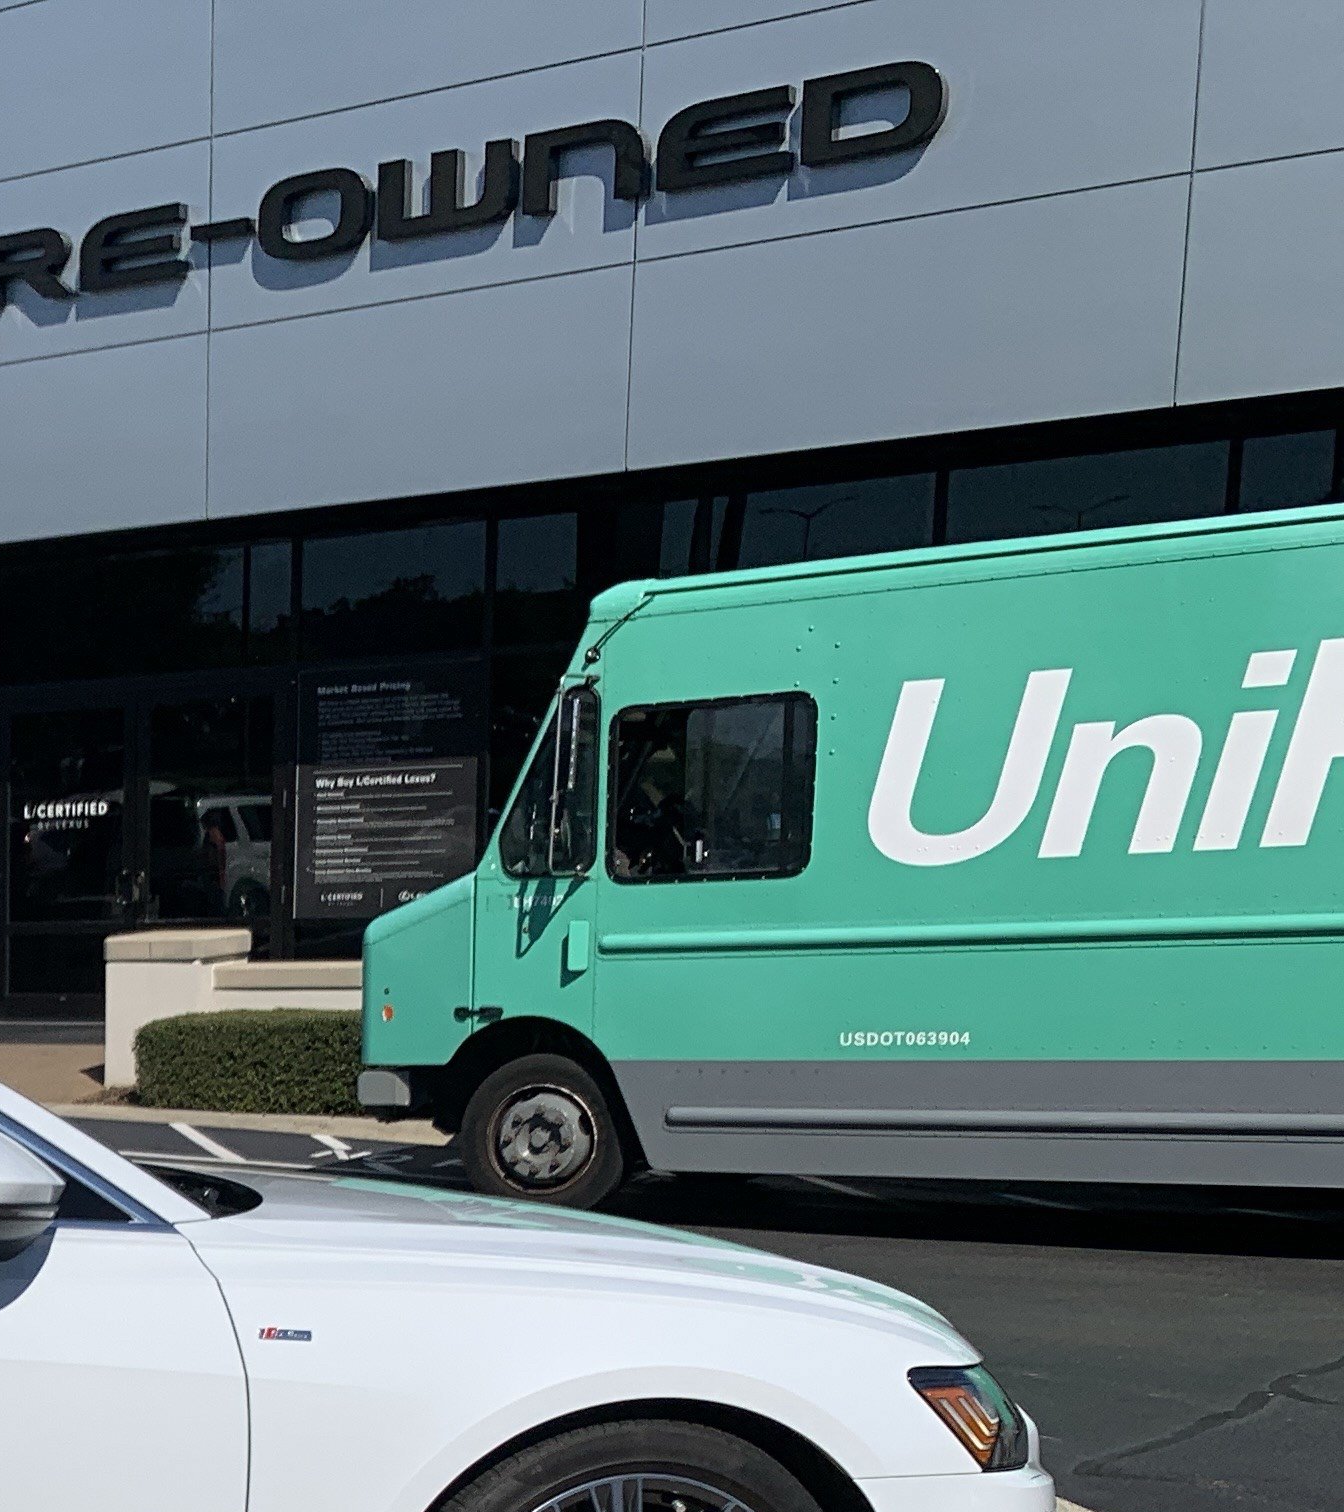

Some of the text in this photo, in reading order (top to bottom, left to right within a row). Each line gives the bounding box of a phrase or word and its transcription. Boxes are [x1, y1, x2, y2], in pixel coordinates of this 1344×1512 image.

[315, 777, 336, 789] Why
[337, 776, 354, 788] Buy
[404, 772, 437, 784] Lexus?
[24, 801, 108, 819] L/CERTIFIED
[839, 1031, 971, 1047] USDOT063904
